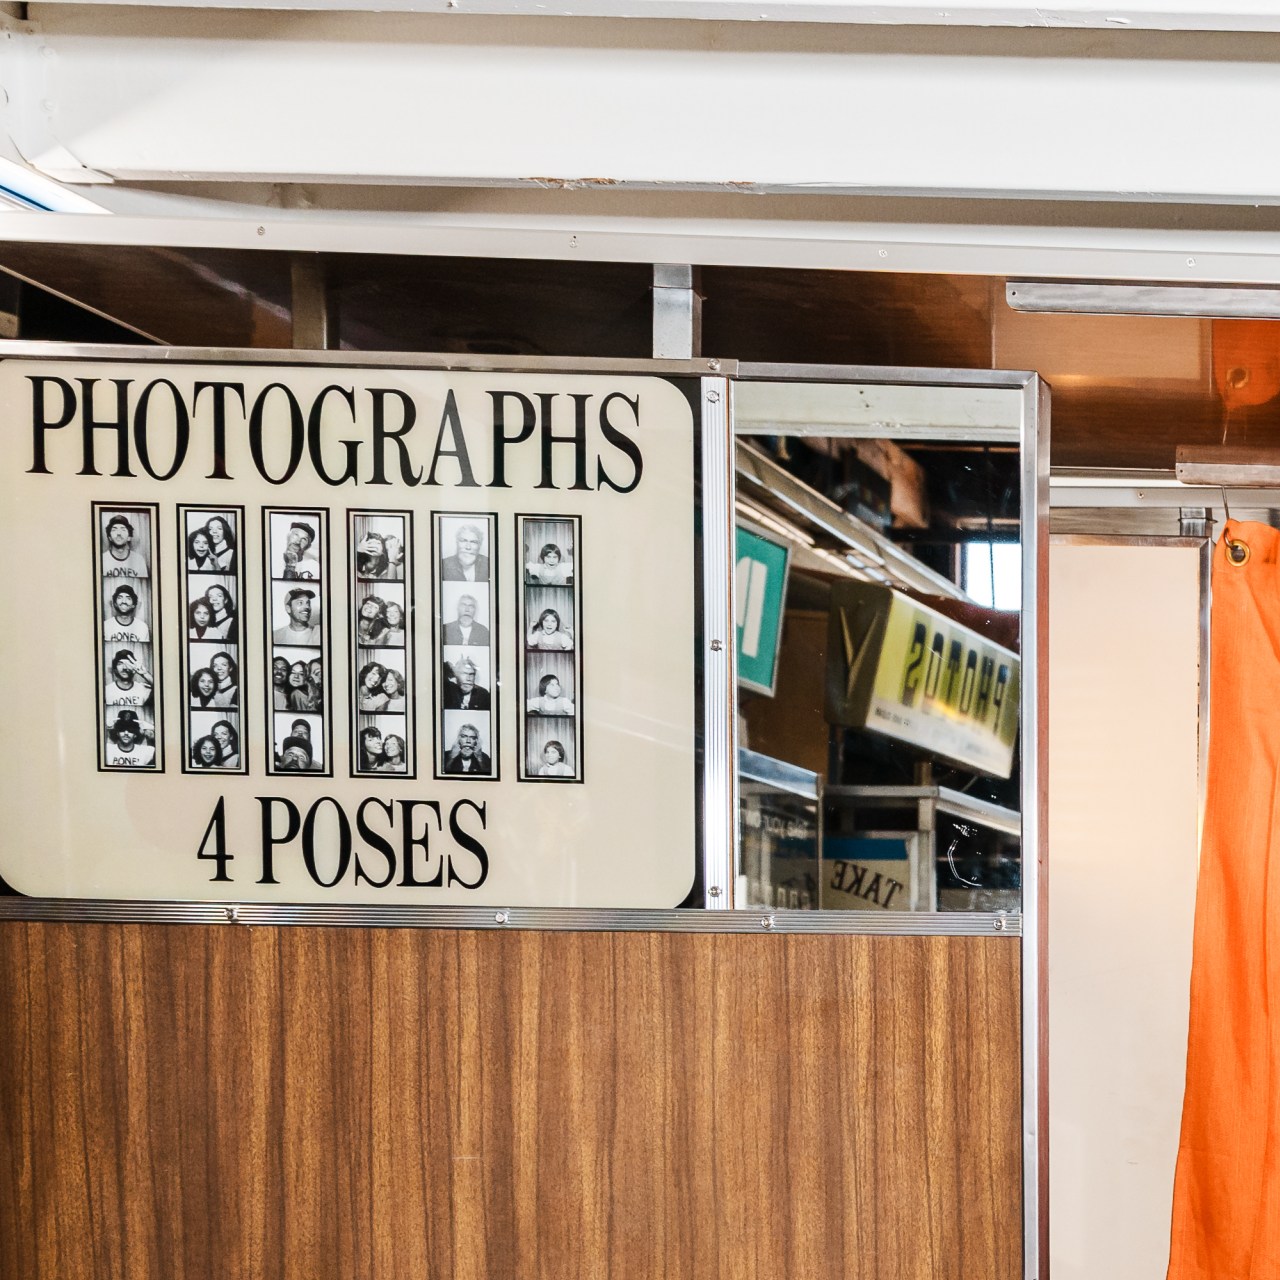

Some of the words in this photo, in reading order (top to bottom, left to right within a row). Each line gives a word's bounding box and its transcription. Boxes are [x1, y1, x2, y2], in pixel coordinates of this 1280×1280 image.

[25, 375, 644, 493] PHOTOGRAPHS
[197, 795, 234, 883] 4
[255, 796, 490, 890] POSES
